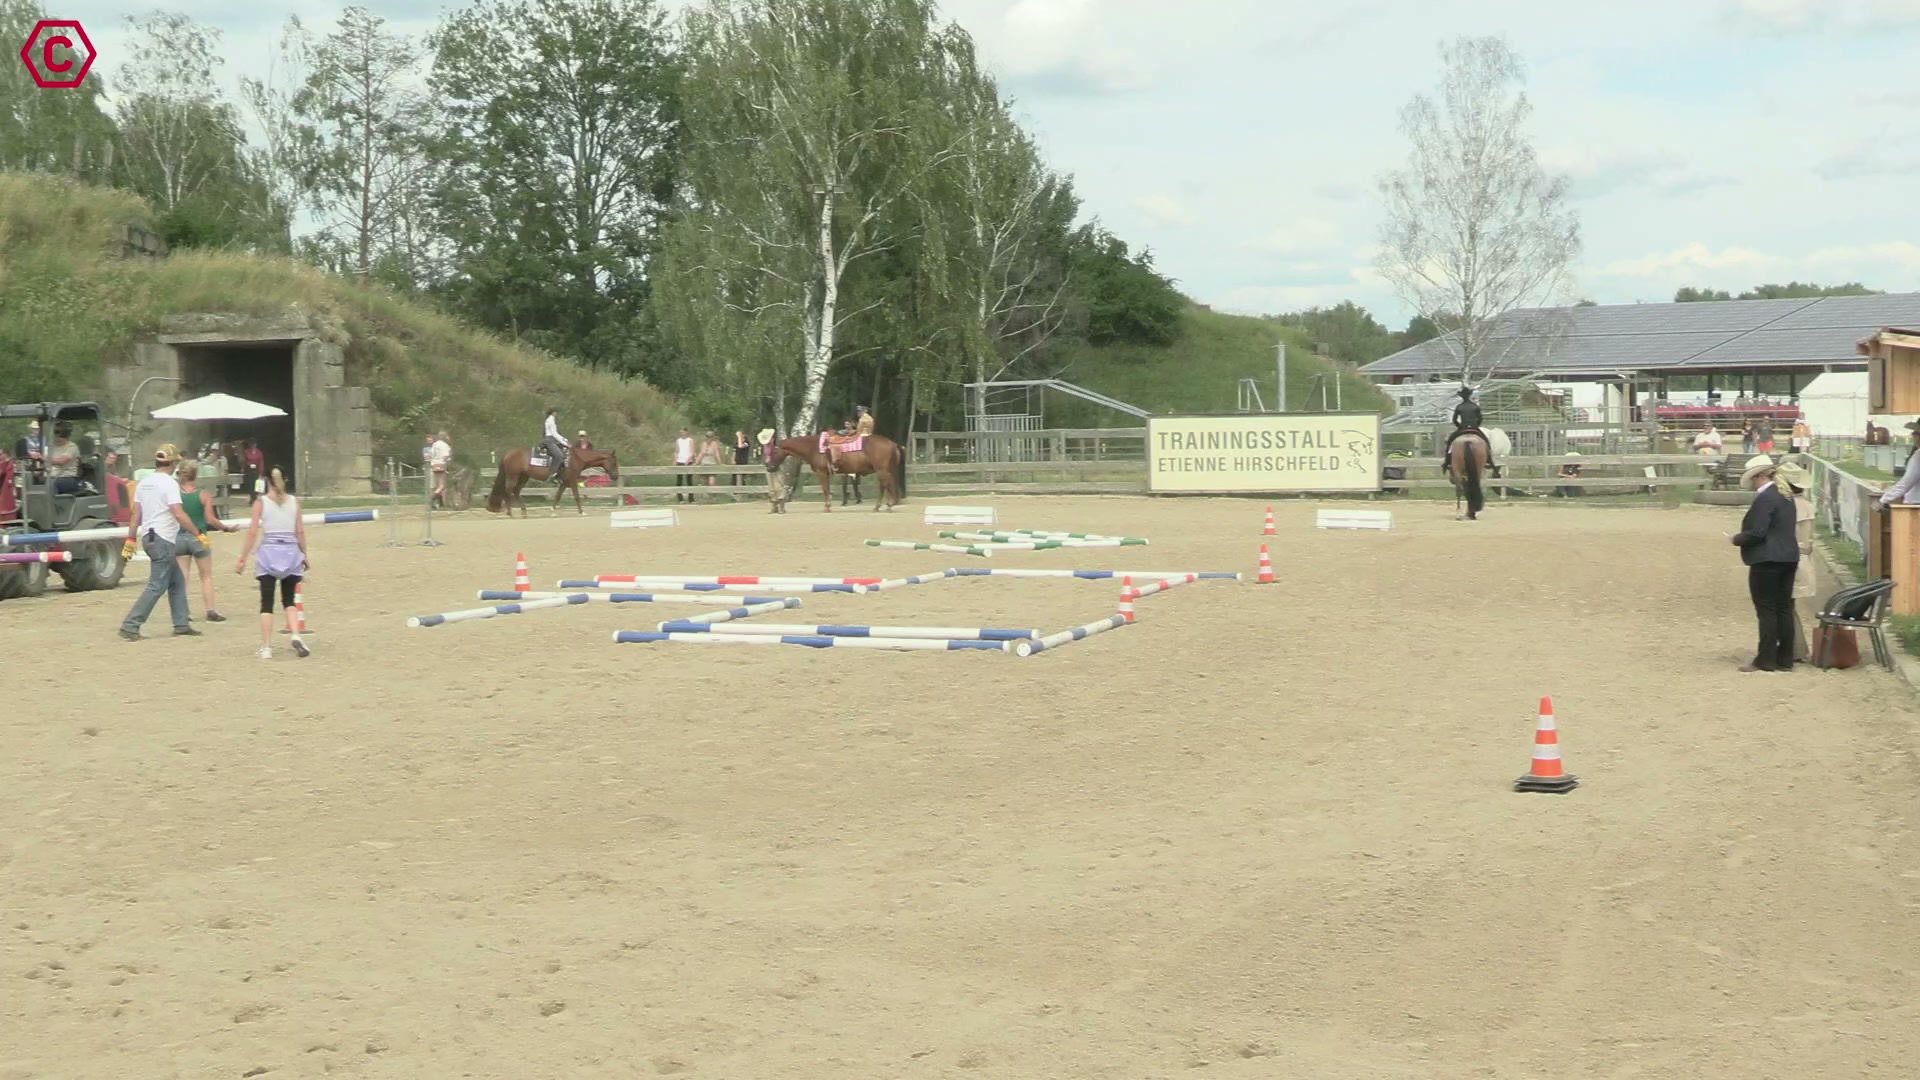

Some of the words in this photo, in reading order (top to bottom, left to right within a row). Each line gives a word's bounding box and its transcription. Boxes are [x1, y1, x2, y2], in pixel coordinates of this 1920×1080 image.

[1158, 430, 1340, 450] TRAININGSSTALL
[1158, 457, 1227, 472] ETIENNE
[1234, 455, 1340, 471] HIRSCHFELD
